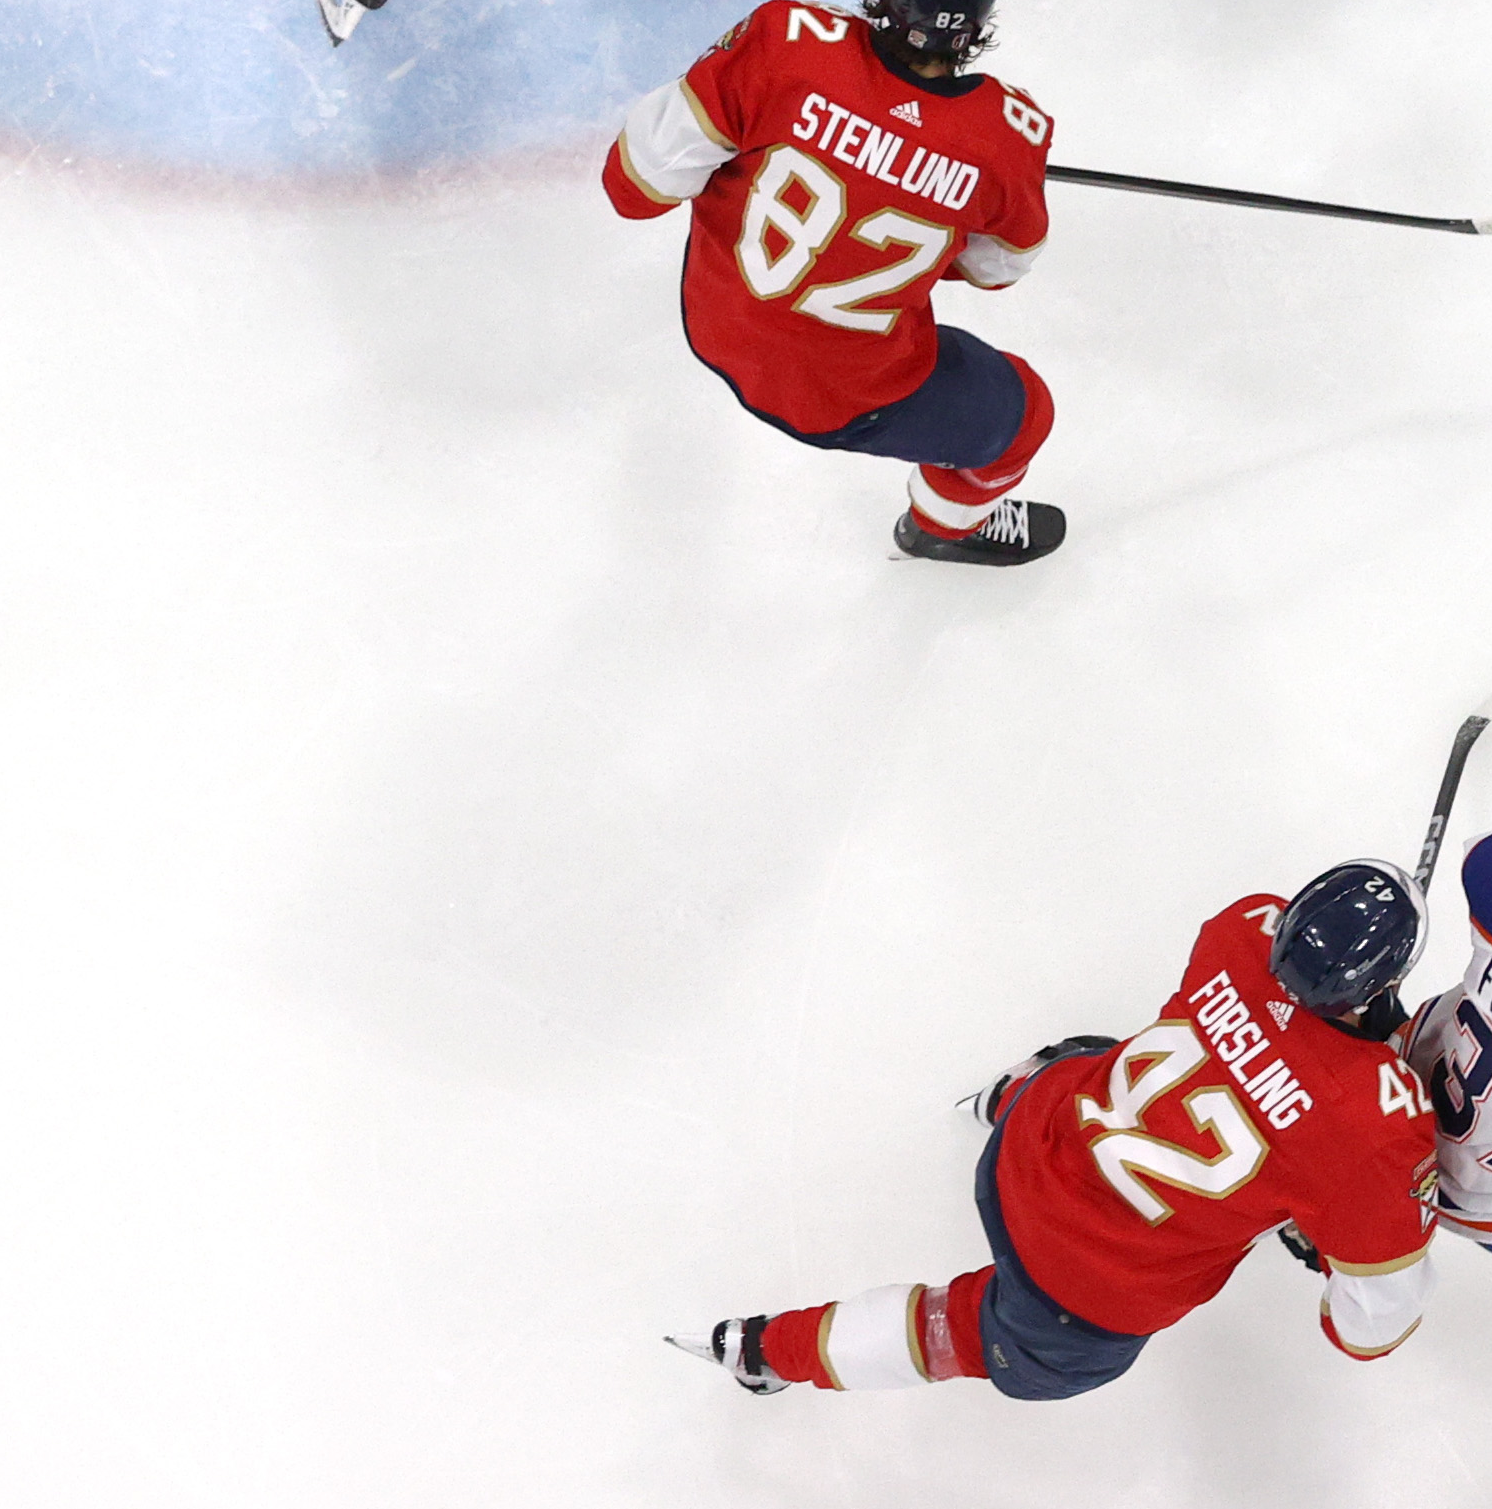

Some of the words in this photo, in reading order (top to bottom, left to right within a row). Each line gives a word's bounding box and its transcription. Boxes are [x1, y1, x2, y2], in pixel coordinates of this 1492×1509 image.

[935, 11, 967, 30] 82
[889, 107, 923, 128] adidas
[792, 92, 981, 211] STENLUND
[735, 142, 955, 336] 82
[1364, 875, 1396, 903] 42
[1266, 1000, 1289, 1033] adidas
[1188, 969, 1314, 1130] FORSLING
[1378, 1058, 1435, 1120] 42
[1075, 1018, 1271, 1227] 42
